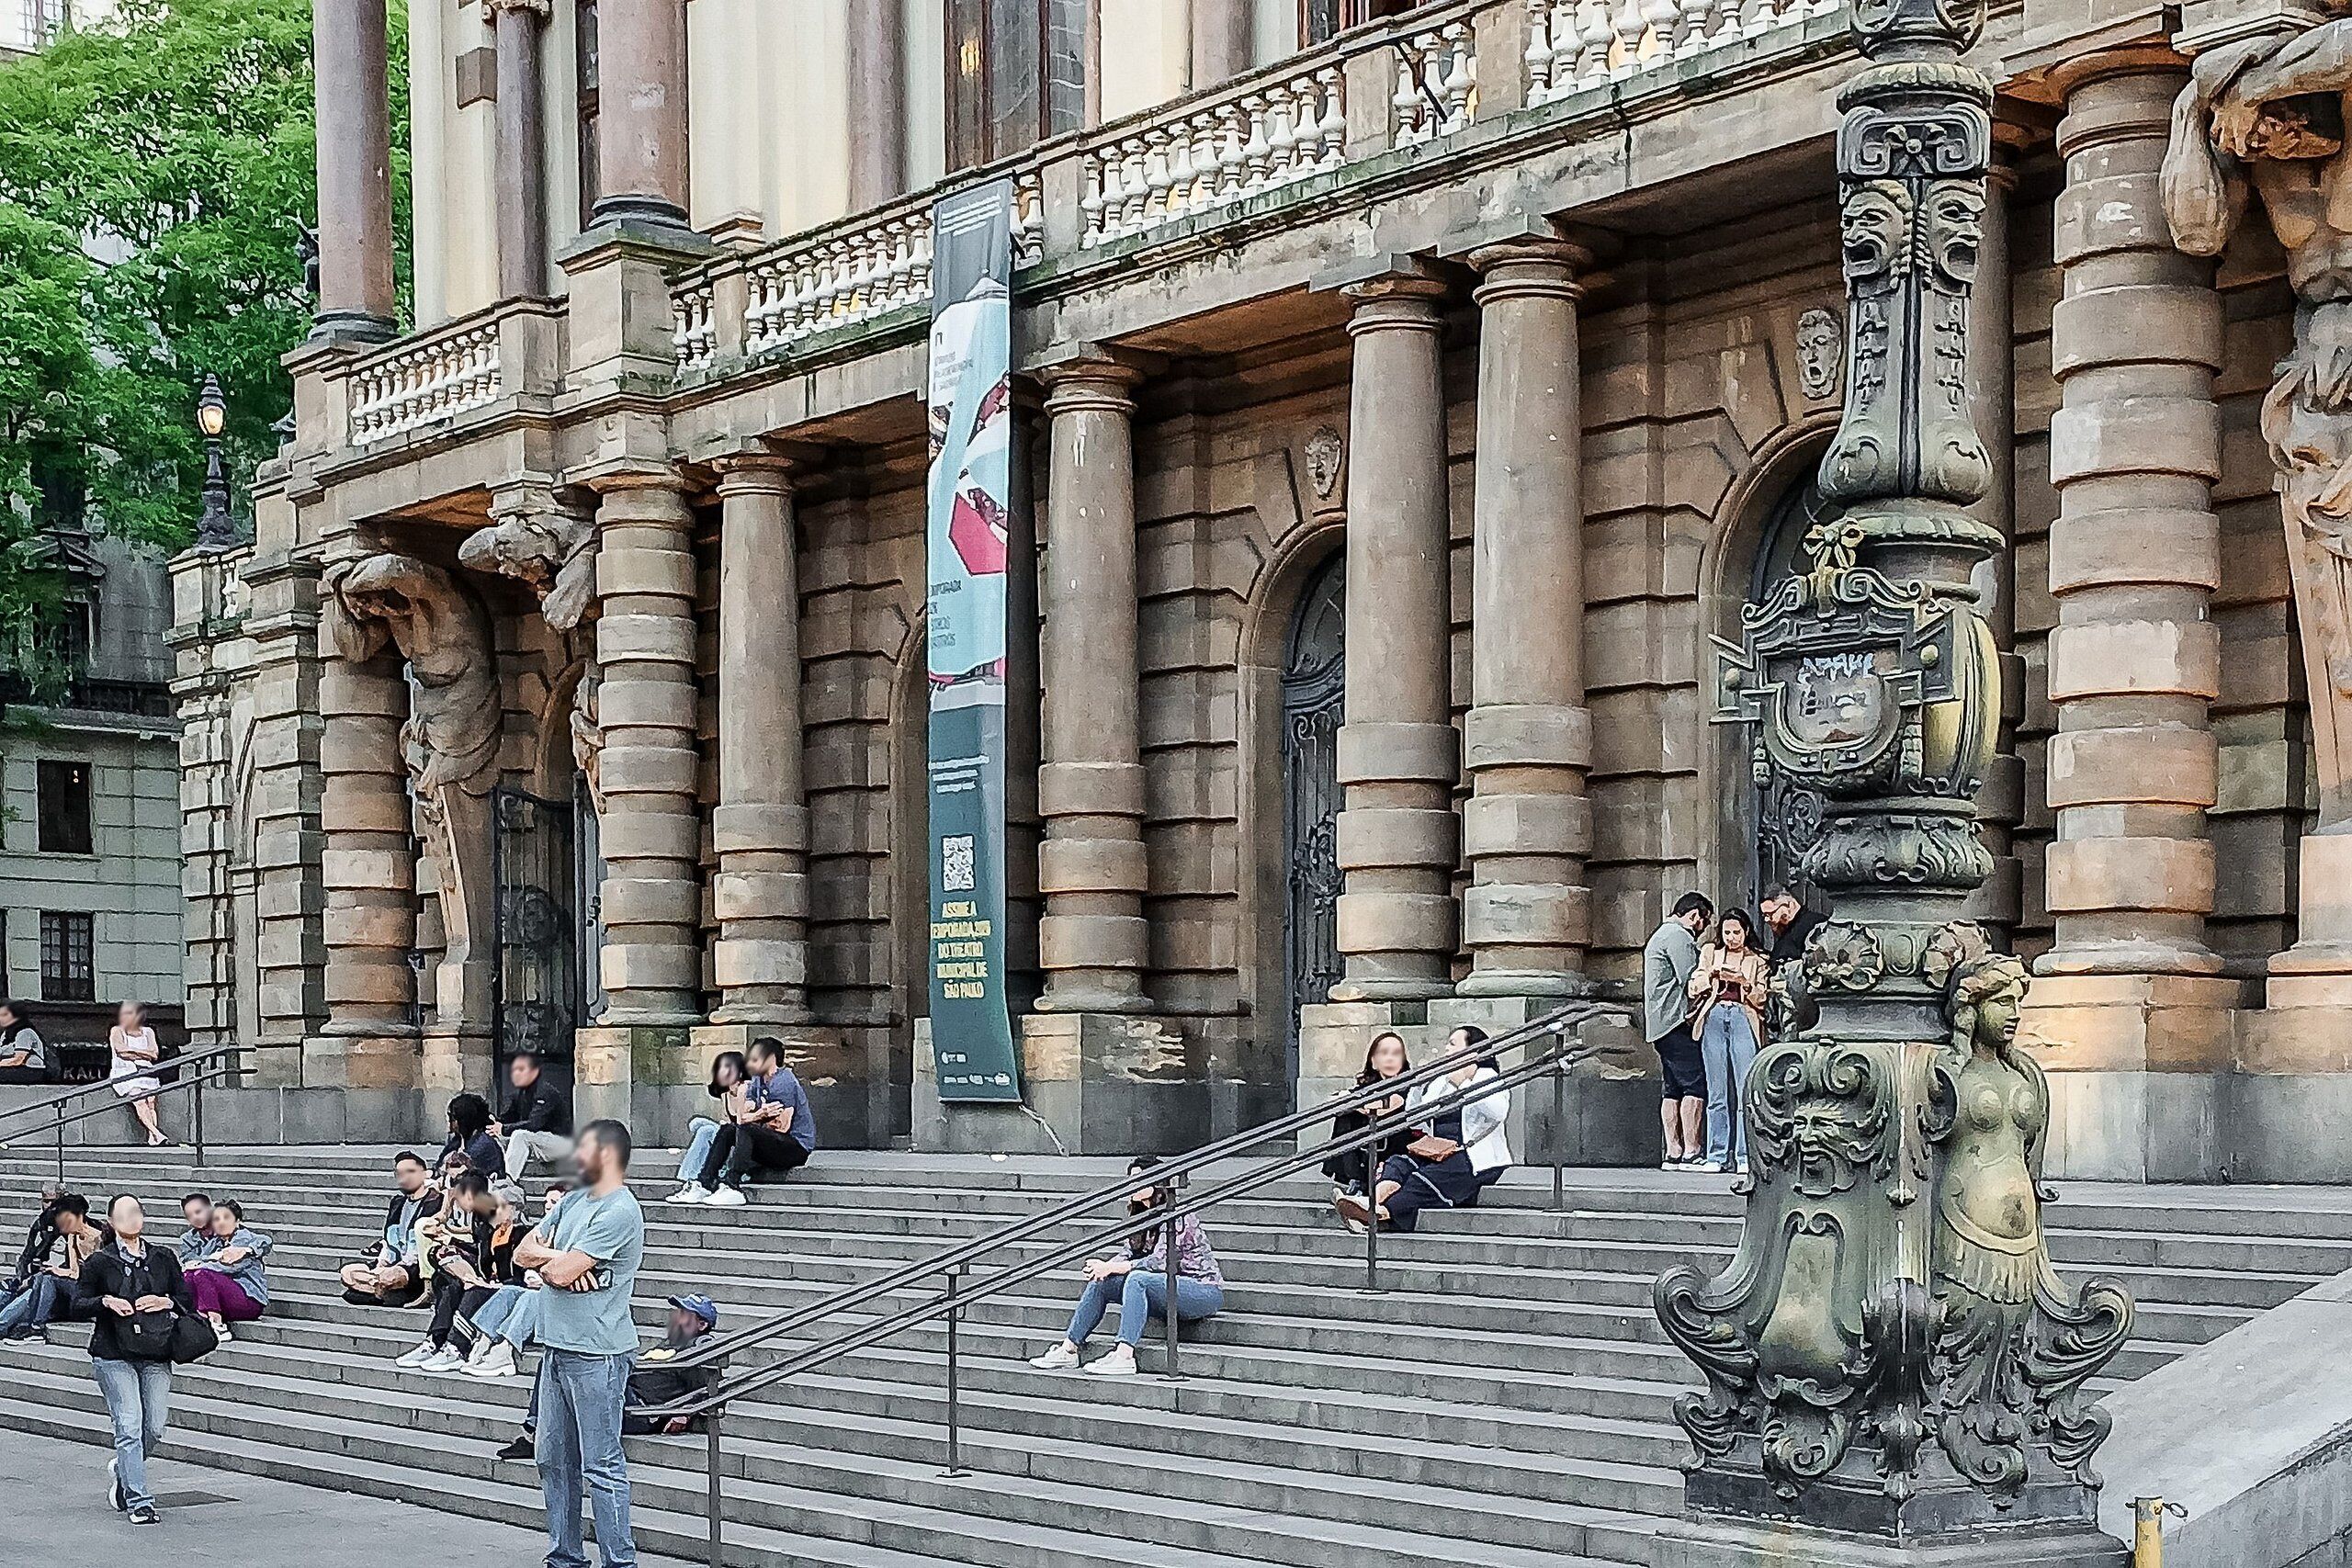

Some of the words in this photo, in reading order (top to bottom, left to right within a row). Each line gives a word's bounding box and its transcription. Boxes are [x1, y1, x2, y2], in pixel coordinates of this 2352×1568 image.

[938, 942, 951, 958] DO
[975, 962, 989, 977] DE
[944, 979, 959, 998] SÃO
[960, 982, 984, 998] PAULO
